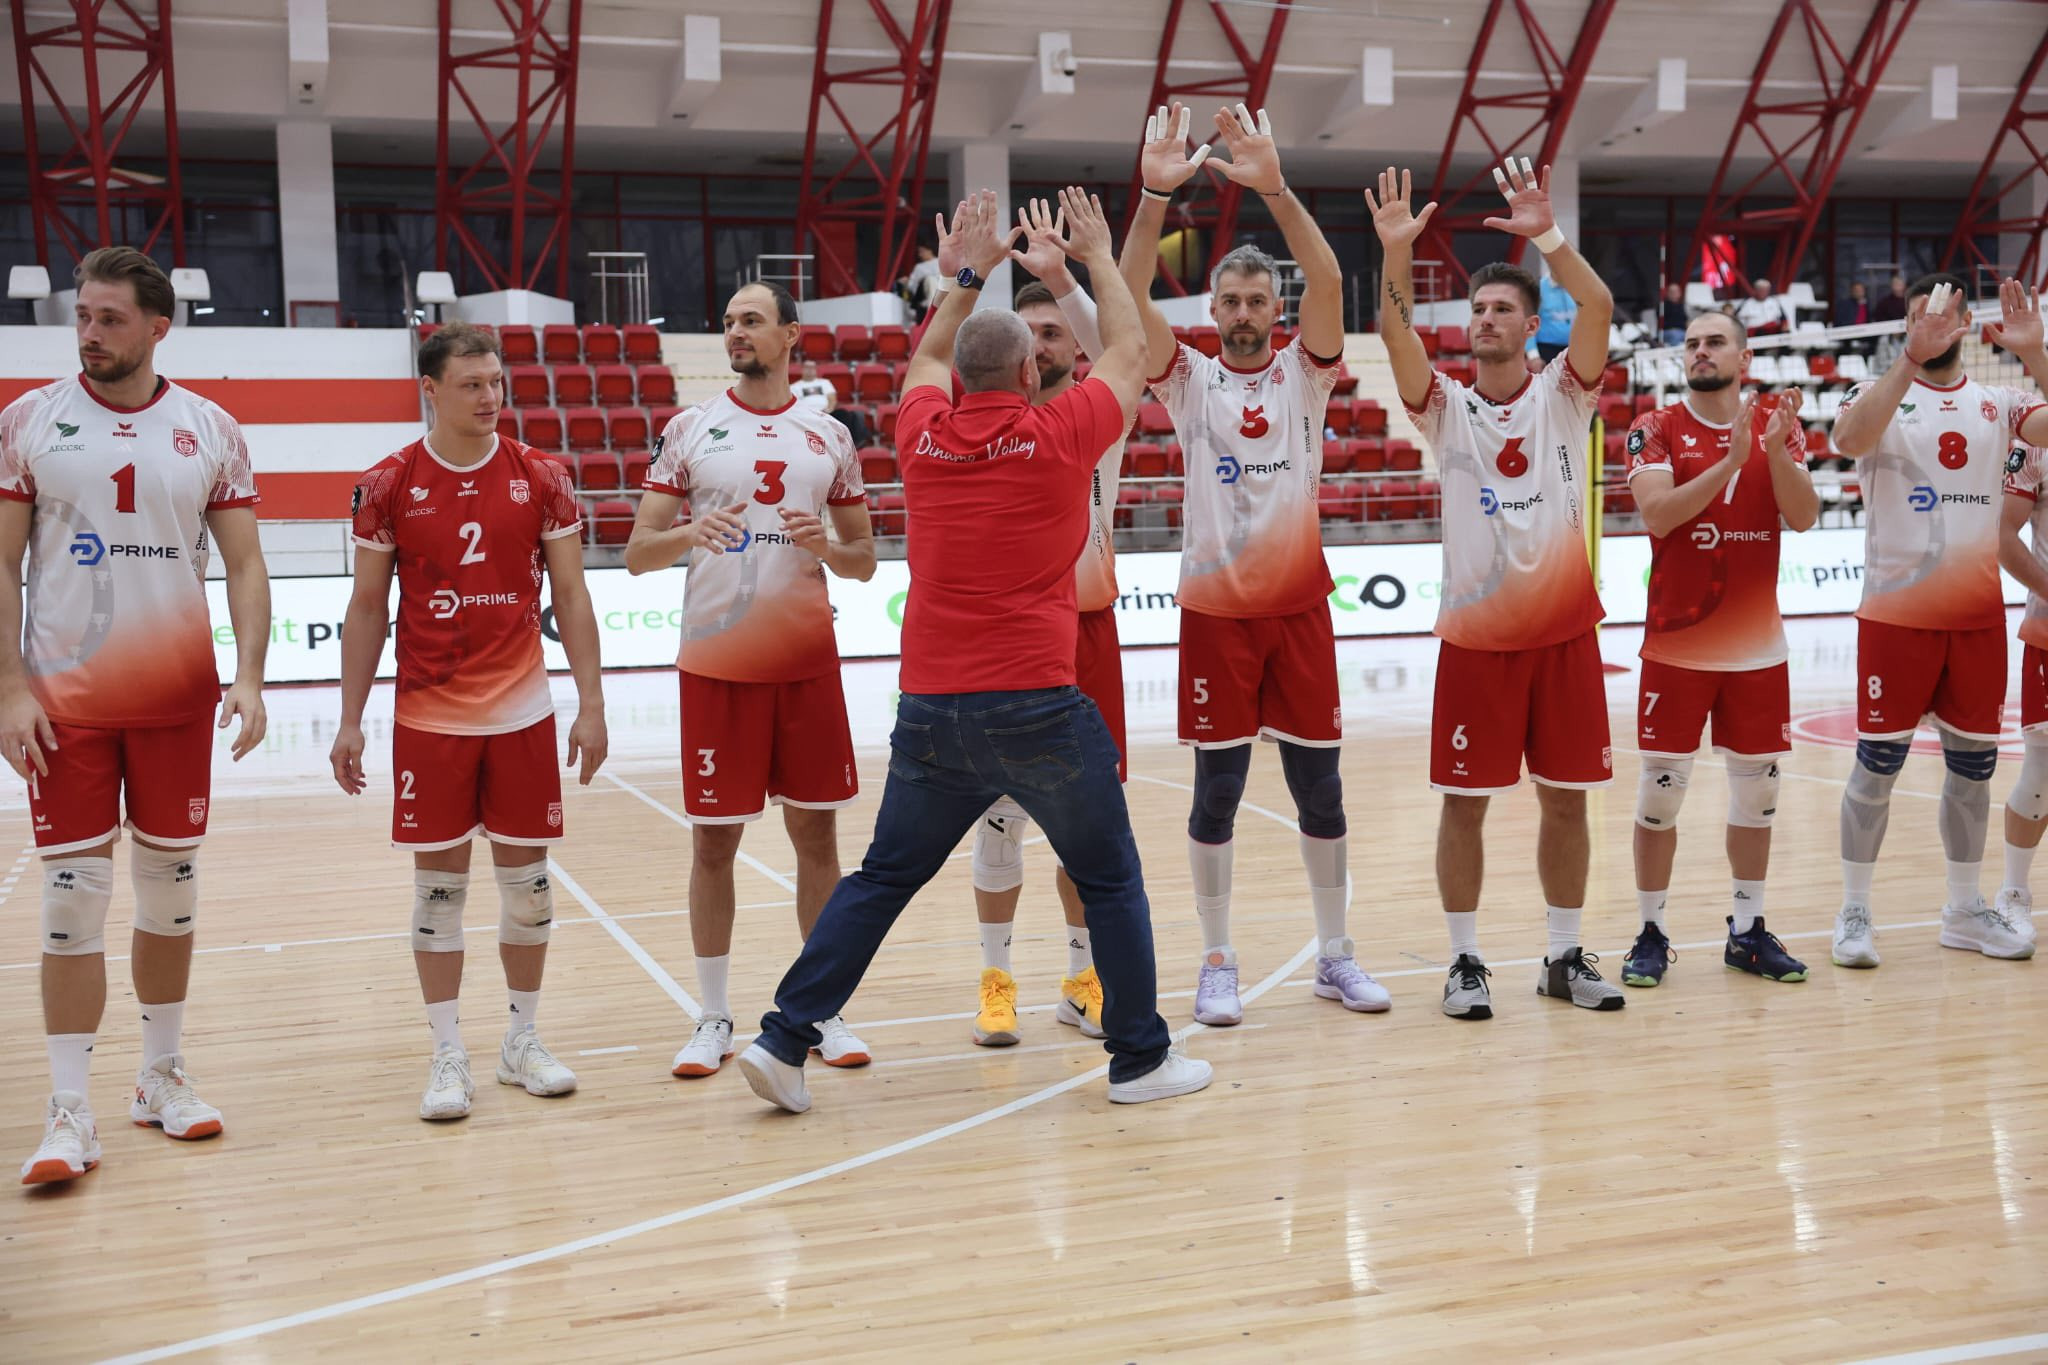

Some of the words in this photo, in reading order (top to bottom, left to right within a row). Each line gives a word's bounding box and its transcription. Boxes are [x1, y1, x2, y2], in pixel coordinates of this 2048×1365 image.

[1240, 405, 1269, 439] 5
[986, 436, 1036, 461] Volley
[1496, 437, 1529, 478] 6
[1938, 431, 1969, 470] 8
[1561, 445, 1573, 481] DRINKS
[110, 462, 137, 514] 1
[457, 489, 479, 497] erima
[753, 460, 789, 506] 3
[1942, 494, 1991, 505] PRIME
[458, 522, 487, 566] 2
[1723, 531, 1771, 541] PRIME
[110, 545, 180, 559] PRIME
[463, 592, 519, 607] PRIME
[1193, 678, 1209, 704] 5
[1867, 675, 1882, 699] 8
[1644, 691, 1661, 716] 7
[1452, 725, 1468, 750] 6
[698, 749, 716, 777] 3
[400, 770, 416, 800] 2
